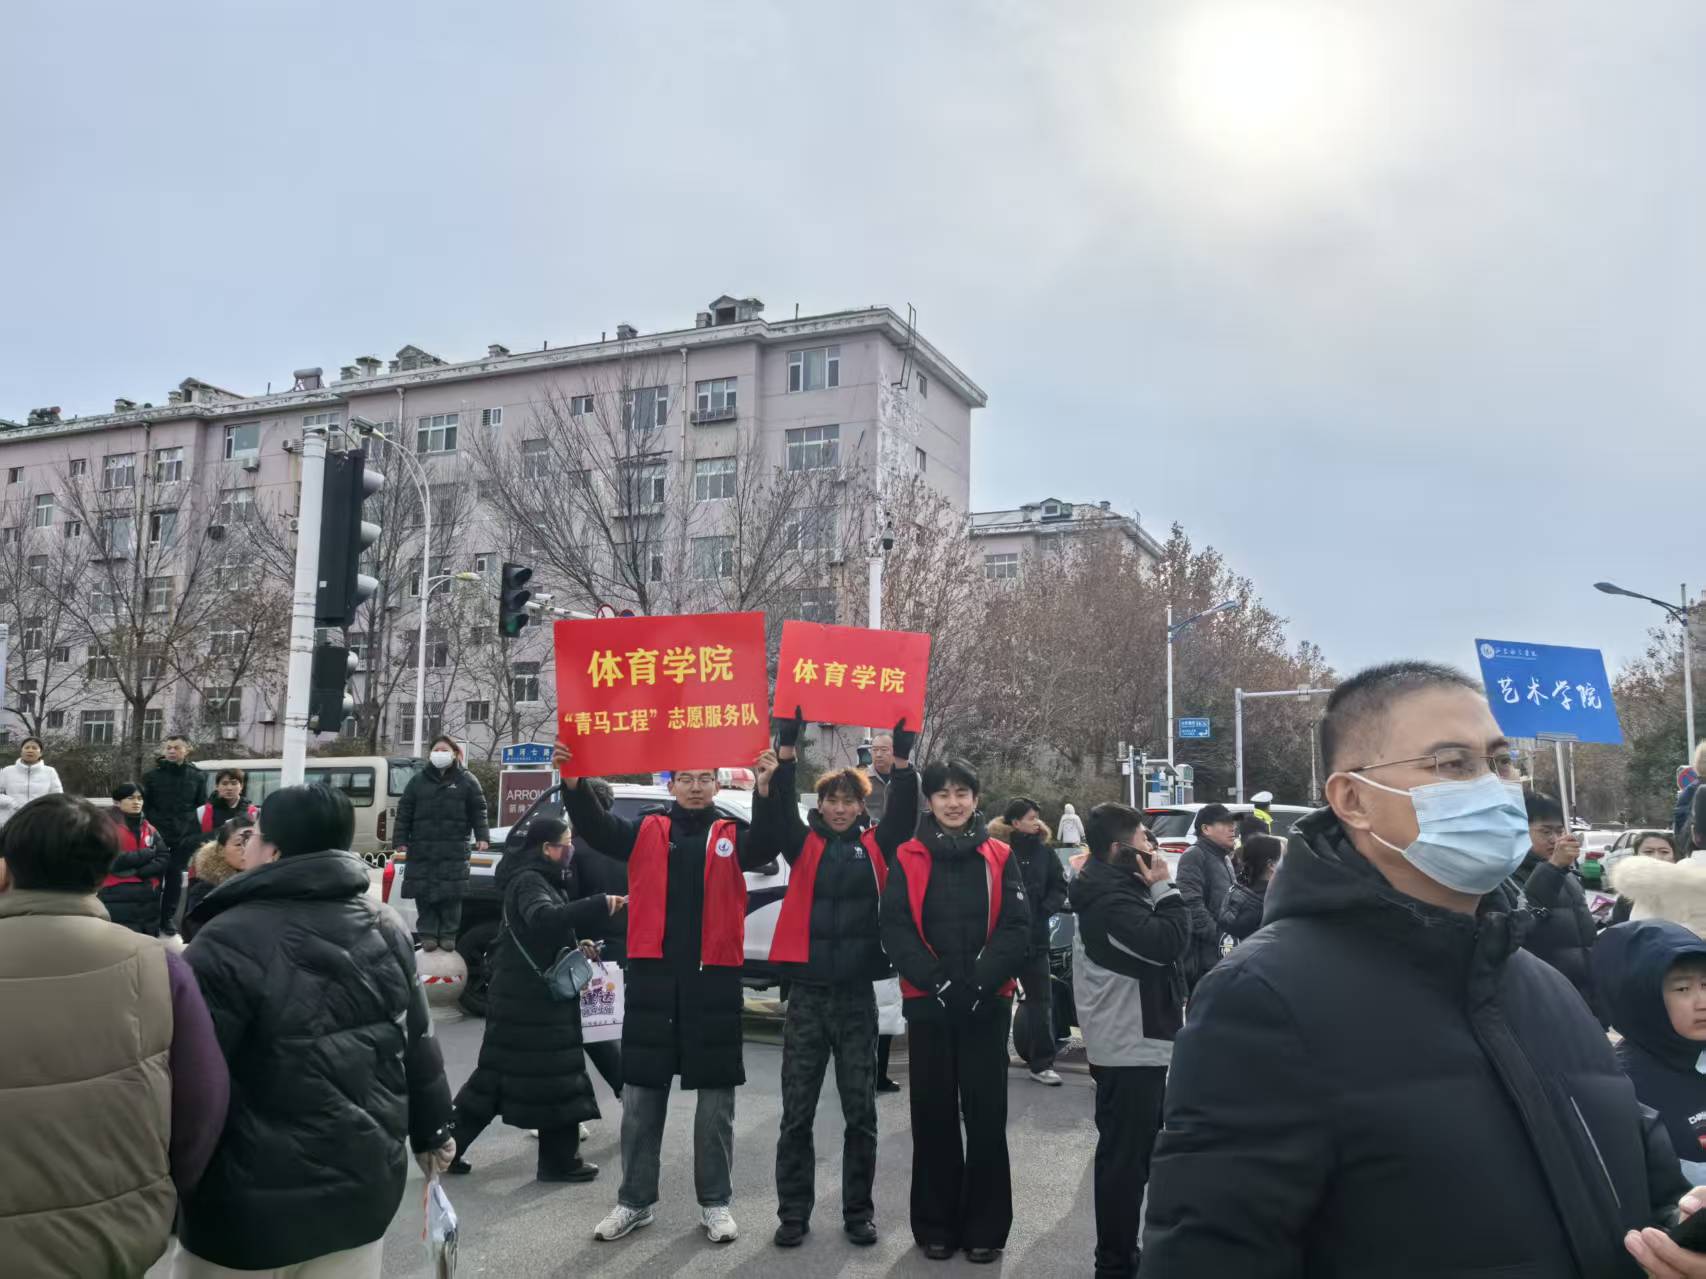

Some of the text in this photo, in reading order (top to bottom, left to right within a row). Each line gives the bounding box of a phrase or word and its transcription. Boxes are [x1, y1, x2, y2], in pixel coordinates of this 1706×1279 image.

[588, 645, 734, 688] 体育学院
[793, 658, 907, 693] 体育学院
[1497, 675, 1603, 711] 艺术学院
